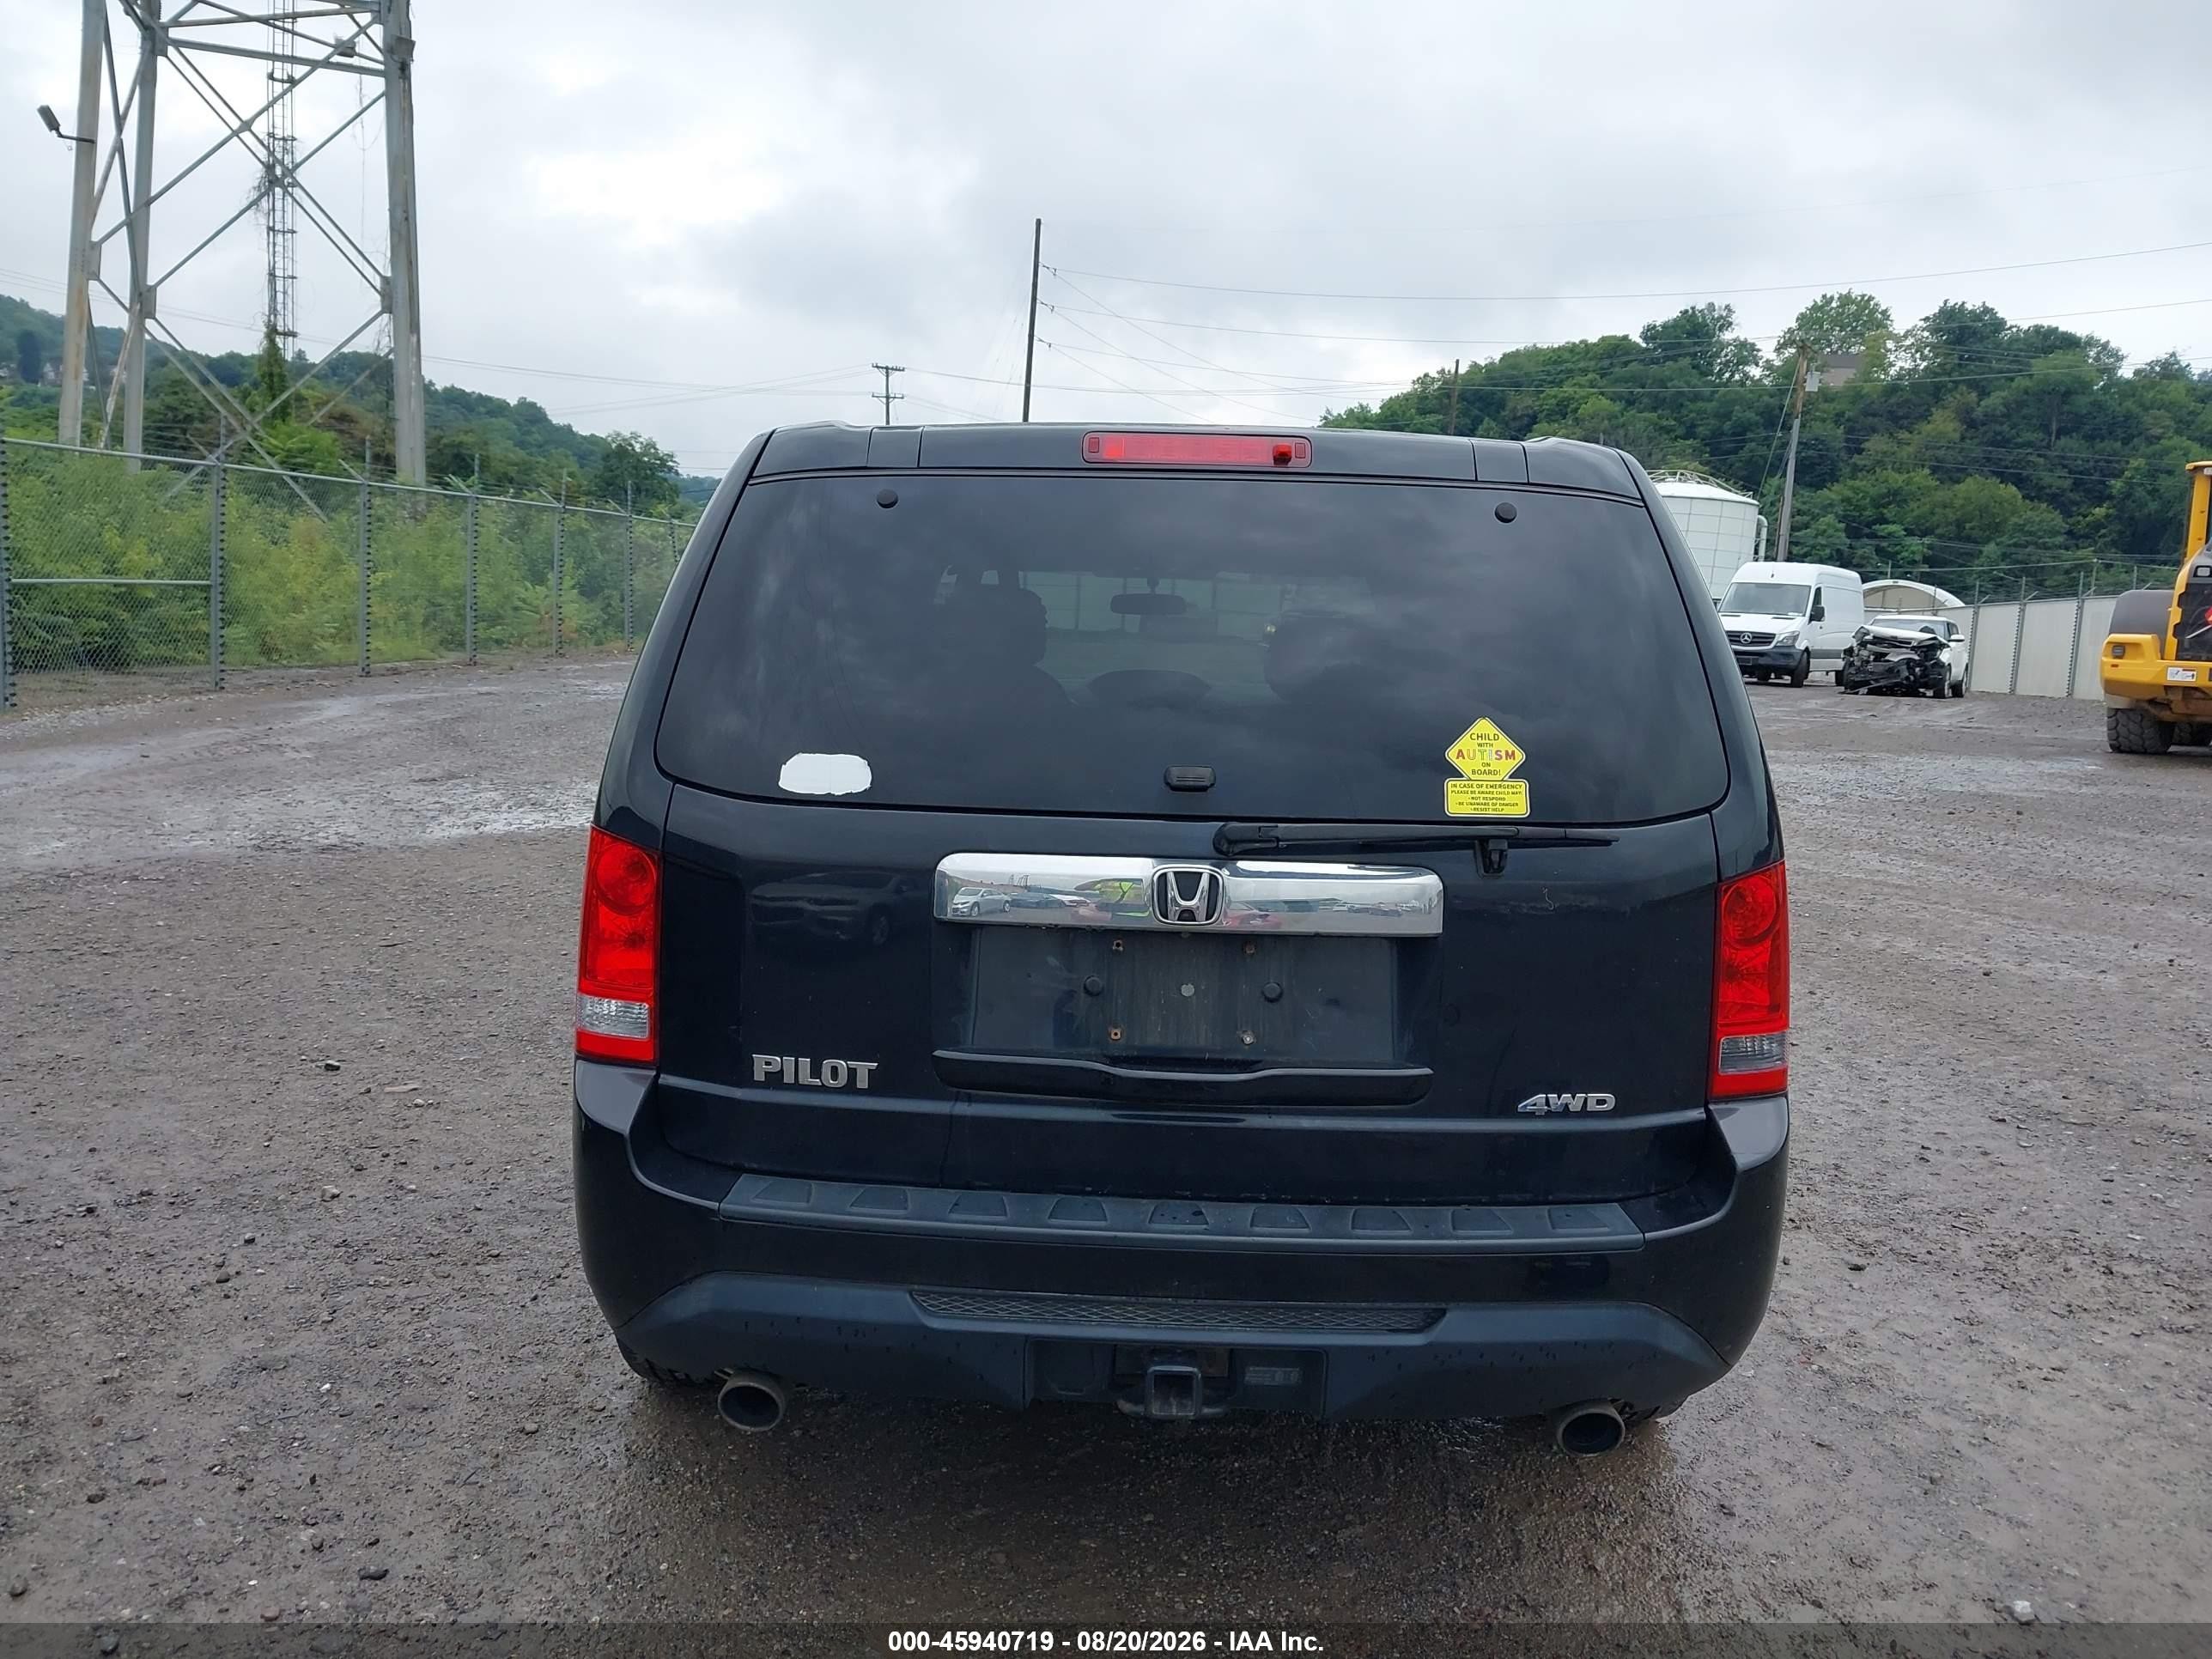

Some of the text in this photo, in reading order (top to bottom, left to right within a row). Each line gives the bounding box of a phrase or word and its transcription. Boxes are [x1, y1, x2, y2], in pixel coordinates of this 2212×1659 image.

[1469, 732, 1499, 741] CHILD
[1455, 749, 1516, 761] AUTISM
[751, 1054, 878, 1089] PILOT
[1517, 1093, 1616, 1115] 4WD
